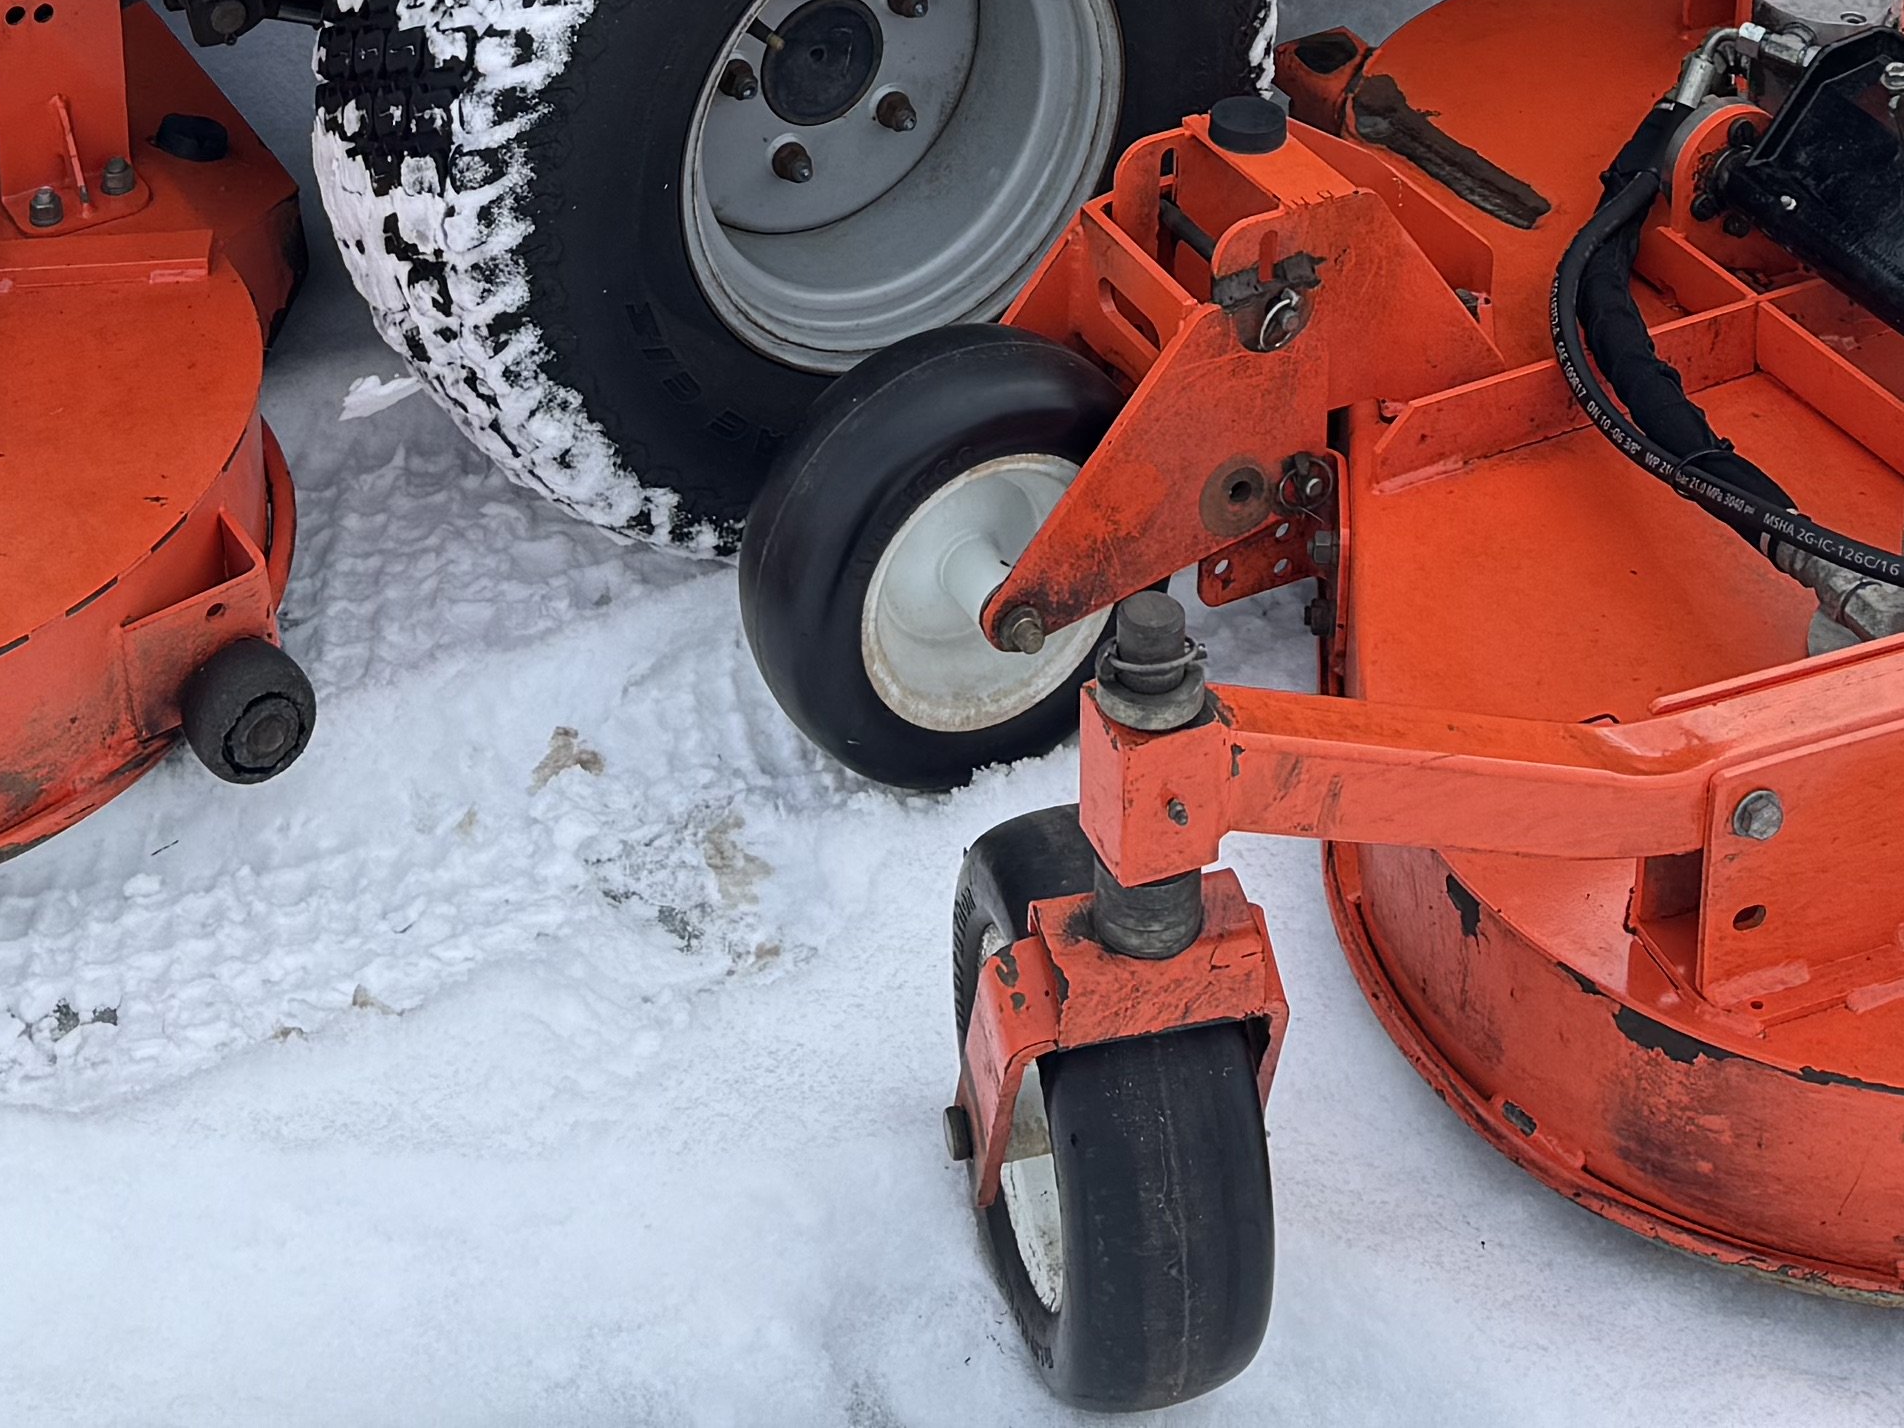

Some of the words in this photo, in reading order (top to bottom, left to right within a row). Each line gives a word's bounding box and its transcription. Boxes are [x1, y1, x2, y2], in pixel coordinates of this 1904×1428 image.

[1599, 415, 1611, 431] 10
[1645, 452, 1661, 469] WP
[1722, 493, 1745, 513] 3040
[1763, 512, 1795, 537] MSHA
[1795, 528, 1901, 576] 2G-IC-126C/16
